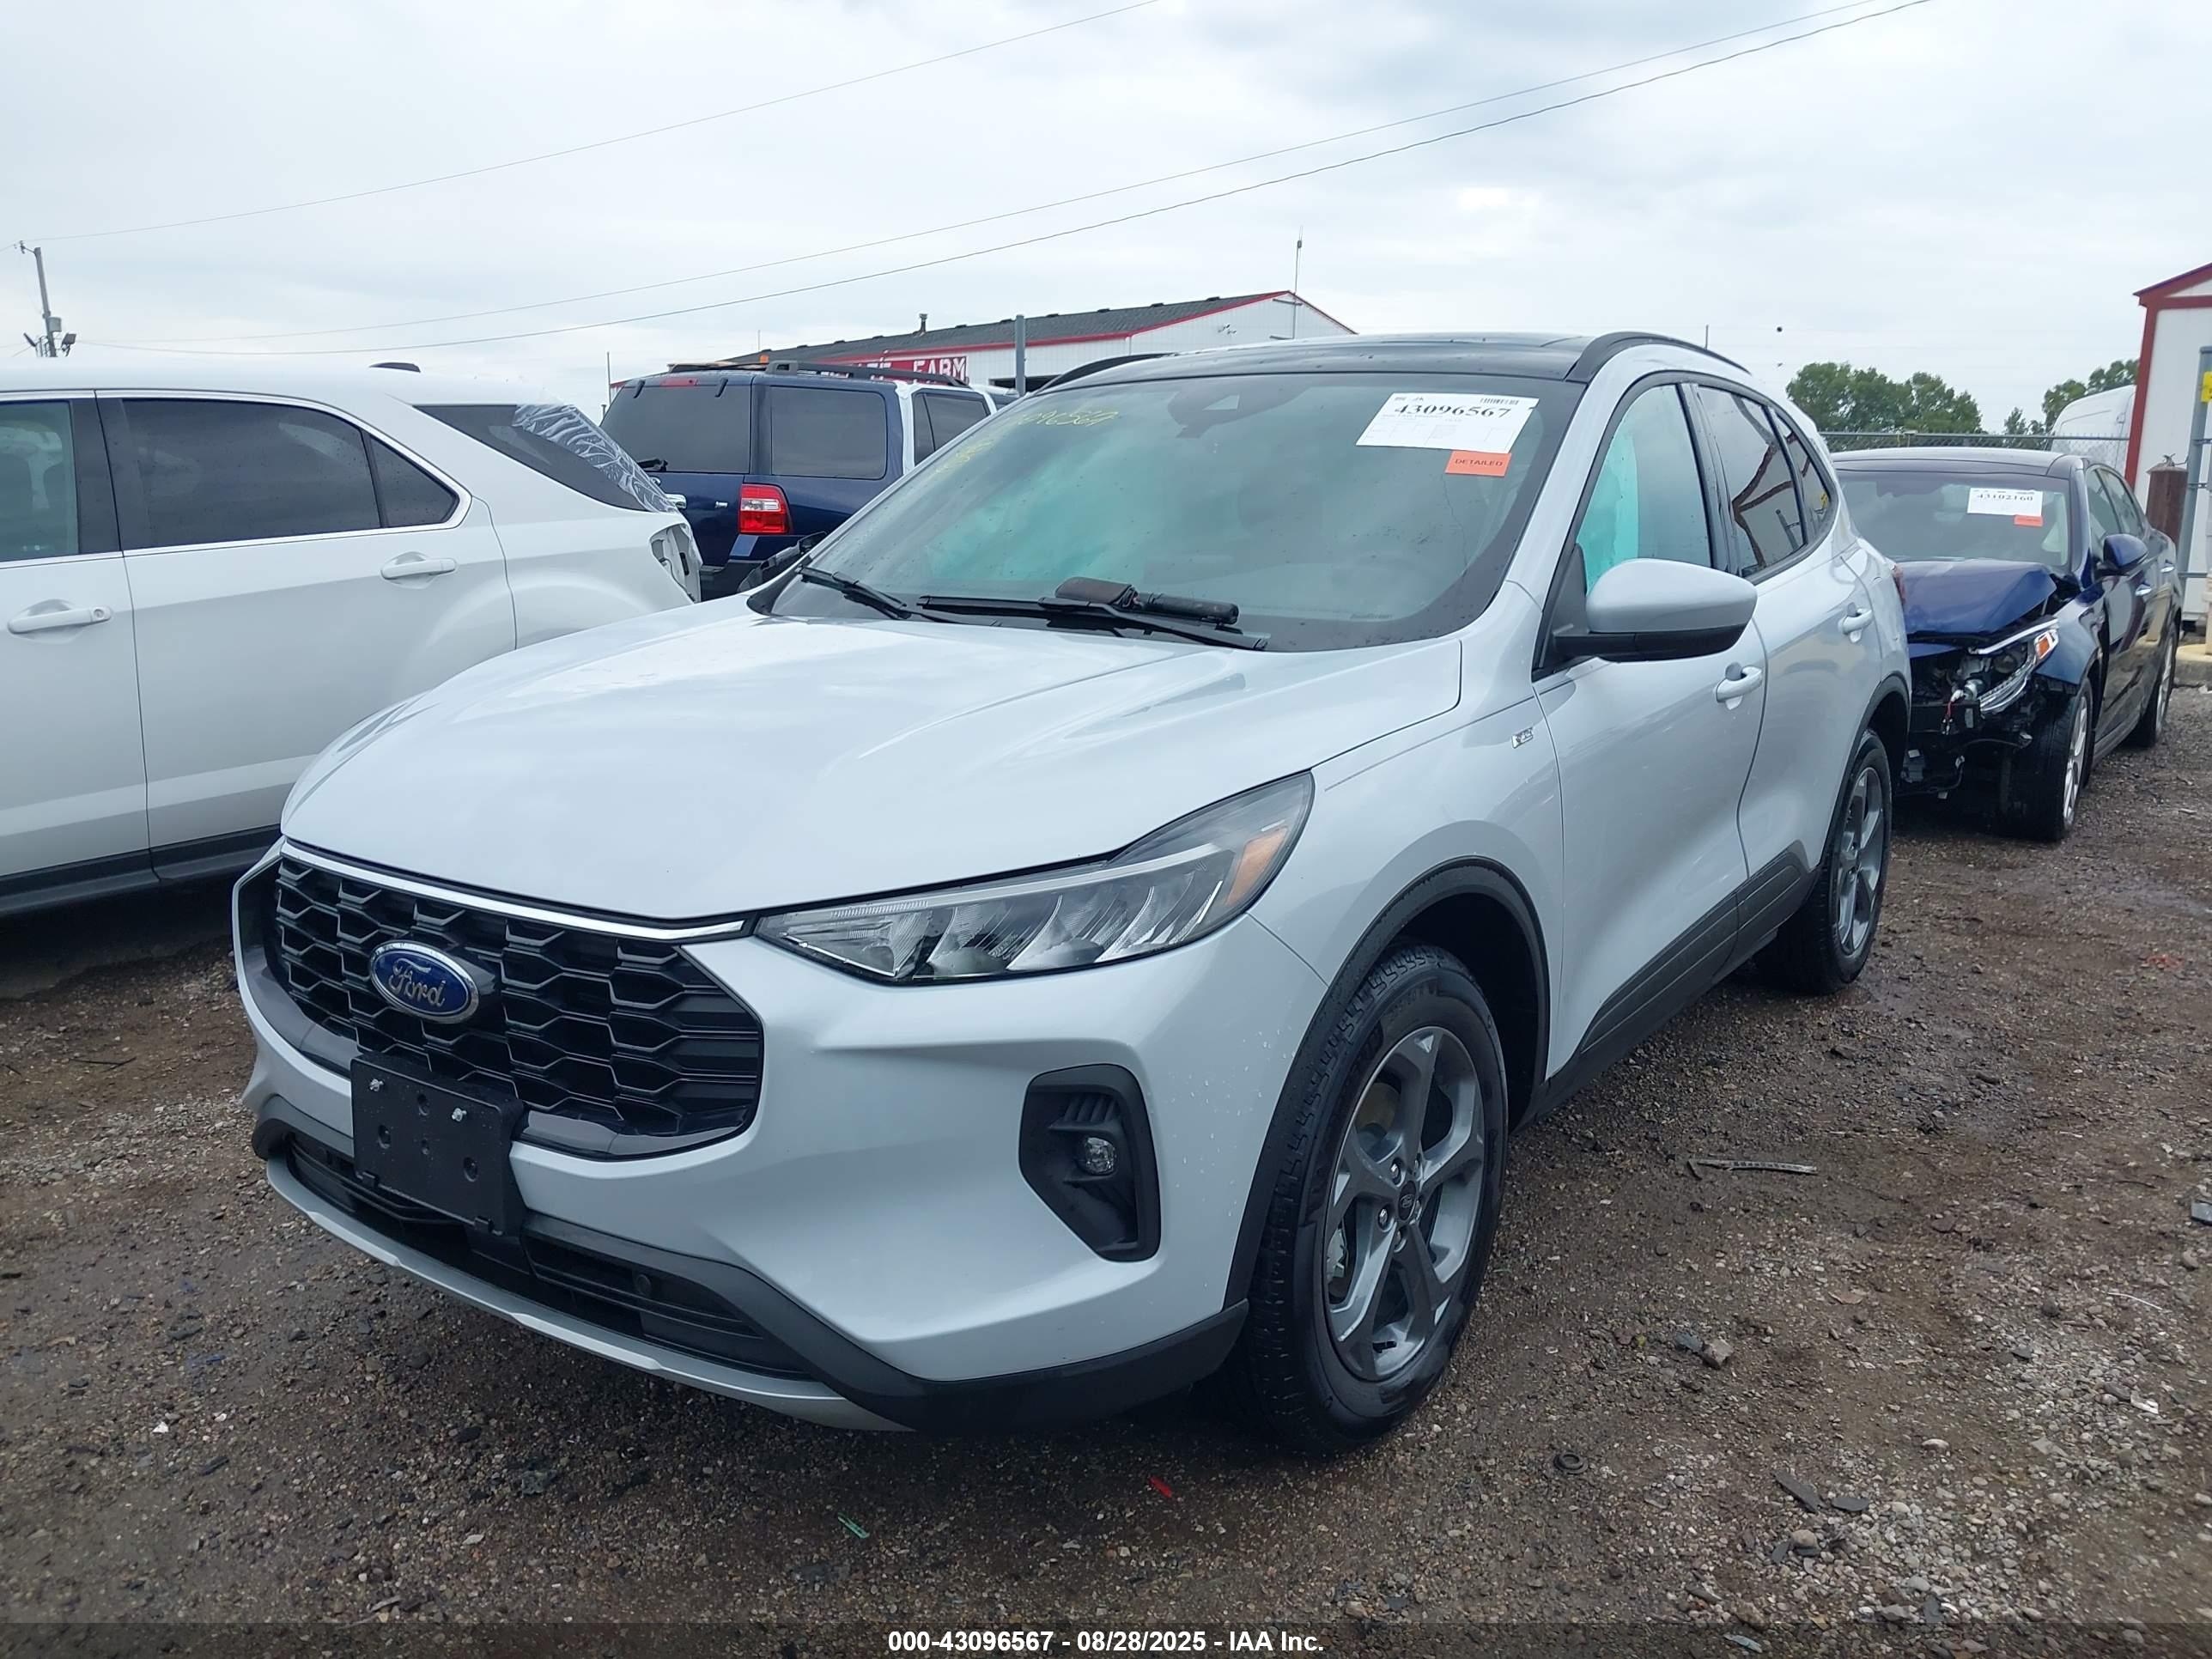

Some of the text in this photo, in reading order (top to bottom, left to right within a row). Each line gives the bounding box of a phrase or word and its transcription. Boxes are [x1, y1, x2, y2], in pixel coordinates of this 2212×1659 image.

[1395, 404, 1512, 418] 43096567
[1454, 458, 1504, 467] DETAILED
[388, 958, 447, 1007] Ford
